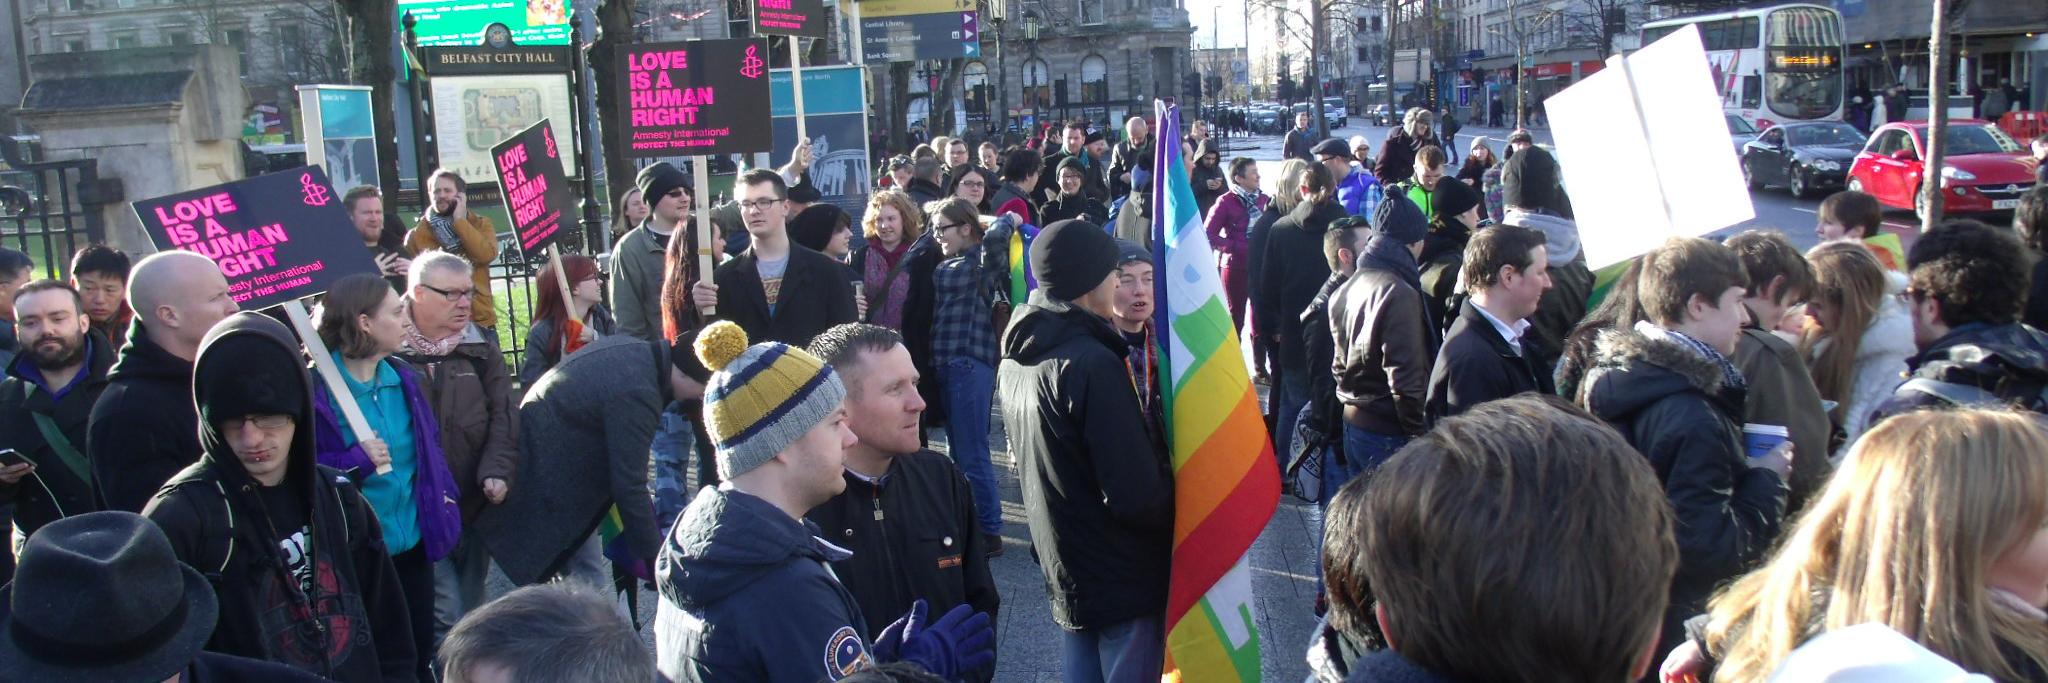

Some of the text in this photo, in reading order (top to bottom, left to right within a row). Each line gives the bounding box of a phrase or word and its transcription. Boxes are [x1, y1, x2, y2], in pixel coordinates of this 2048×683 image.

[441, 52, 556, 64] BELFAST CITY HALL
[628, 50, 688, 72] LOVE
[629, 70, 673, 90] IS A
[630, 87, 714, 108] HUMAN
[631, 107, 699, 127] RIGHT
[632, 139, 715, 150] PROTECT THE HUMAN
[633, 127, 730, 140] Amnesty International
[498, 143, 529, 174] LOVE
[504, 166, 527, 192] IS A
[509, 173, 548, 211] HUMAN
[154, 191, 237, 227] LOVE
[515, 194, 546, 228] RIGHT
[165, 217, 229, 247] IS A
[219, 246, 278, 278] GHT
[228, 260, 324, 293] esty International
[254, 275, 312, 297] THE HUMAN
